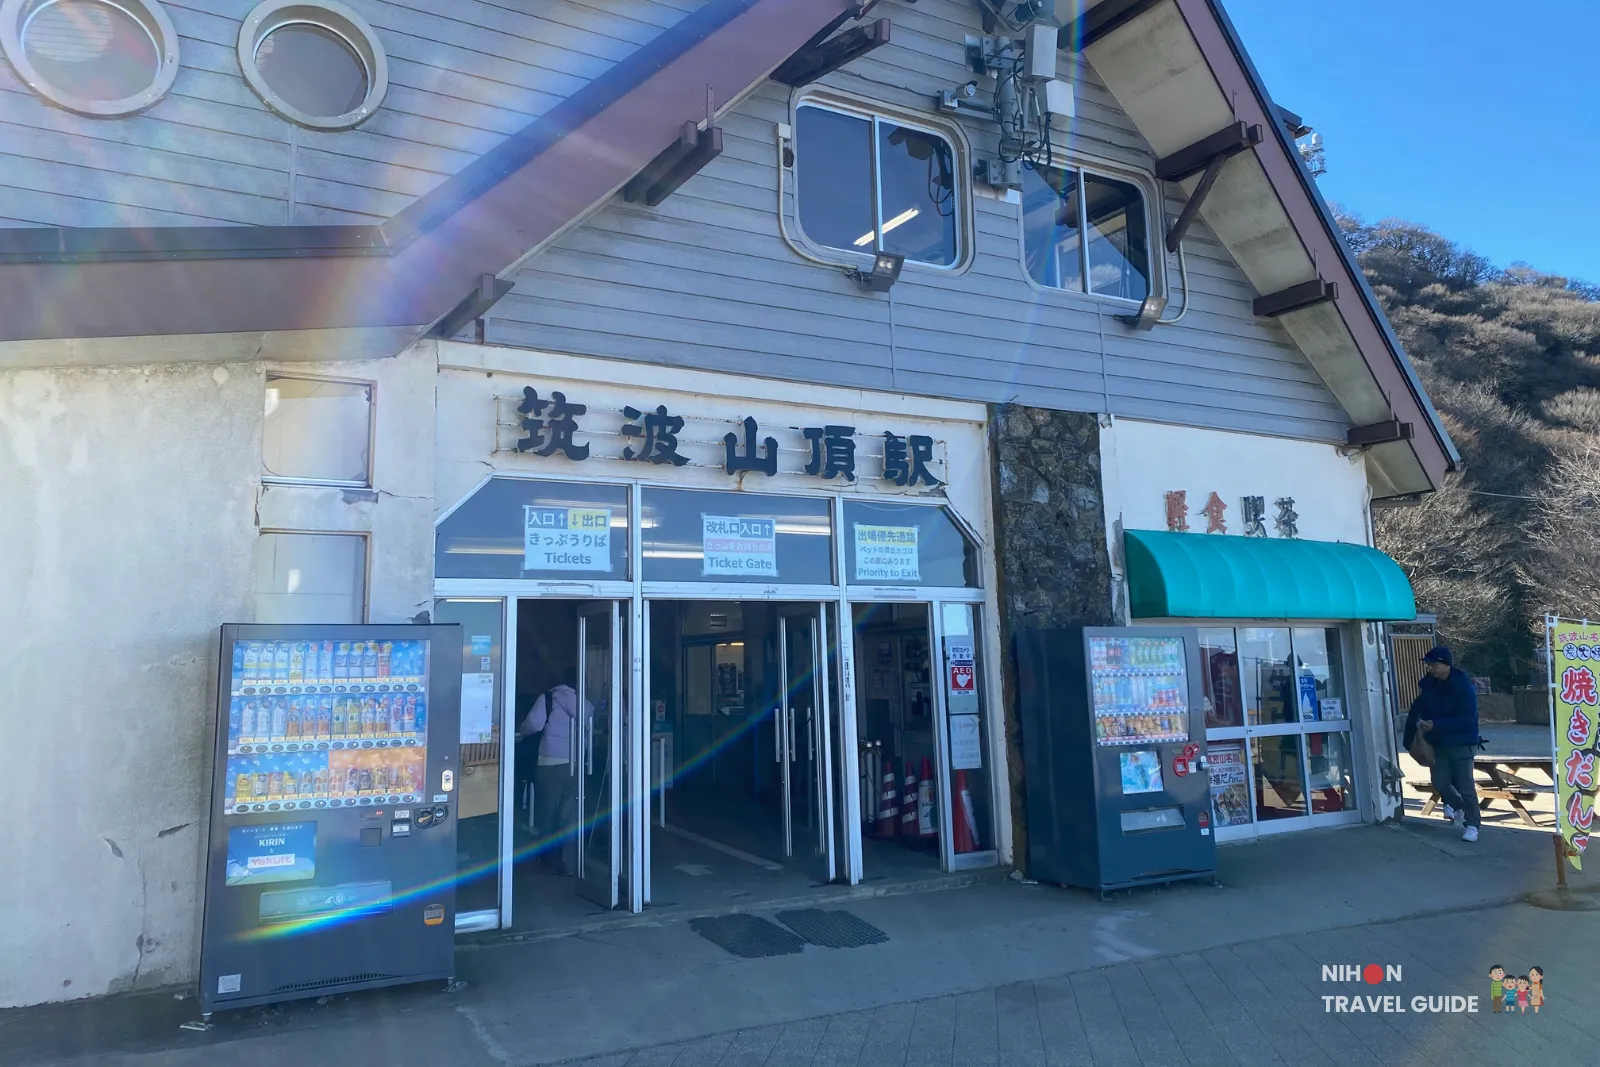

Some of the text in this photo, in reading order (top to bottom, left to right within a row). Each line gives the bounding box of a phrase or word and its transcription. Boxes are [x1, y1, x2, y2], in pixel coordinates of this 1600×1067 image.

[517, 385, 942, 487] 筑波山頂駅
[528, 511, 607, 527] 入口 出口
[706, 520, 762, 535] 改札口 入口
[529, 532, 607, 547] きっぷうりば
[544, 552, 592, 564] Tickets
[708, 557, 772, 569] Ticket Gate
[858, 568, 918, 578] Priority to Exit
[259, 837, 285, 847] KIRIN
